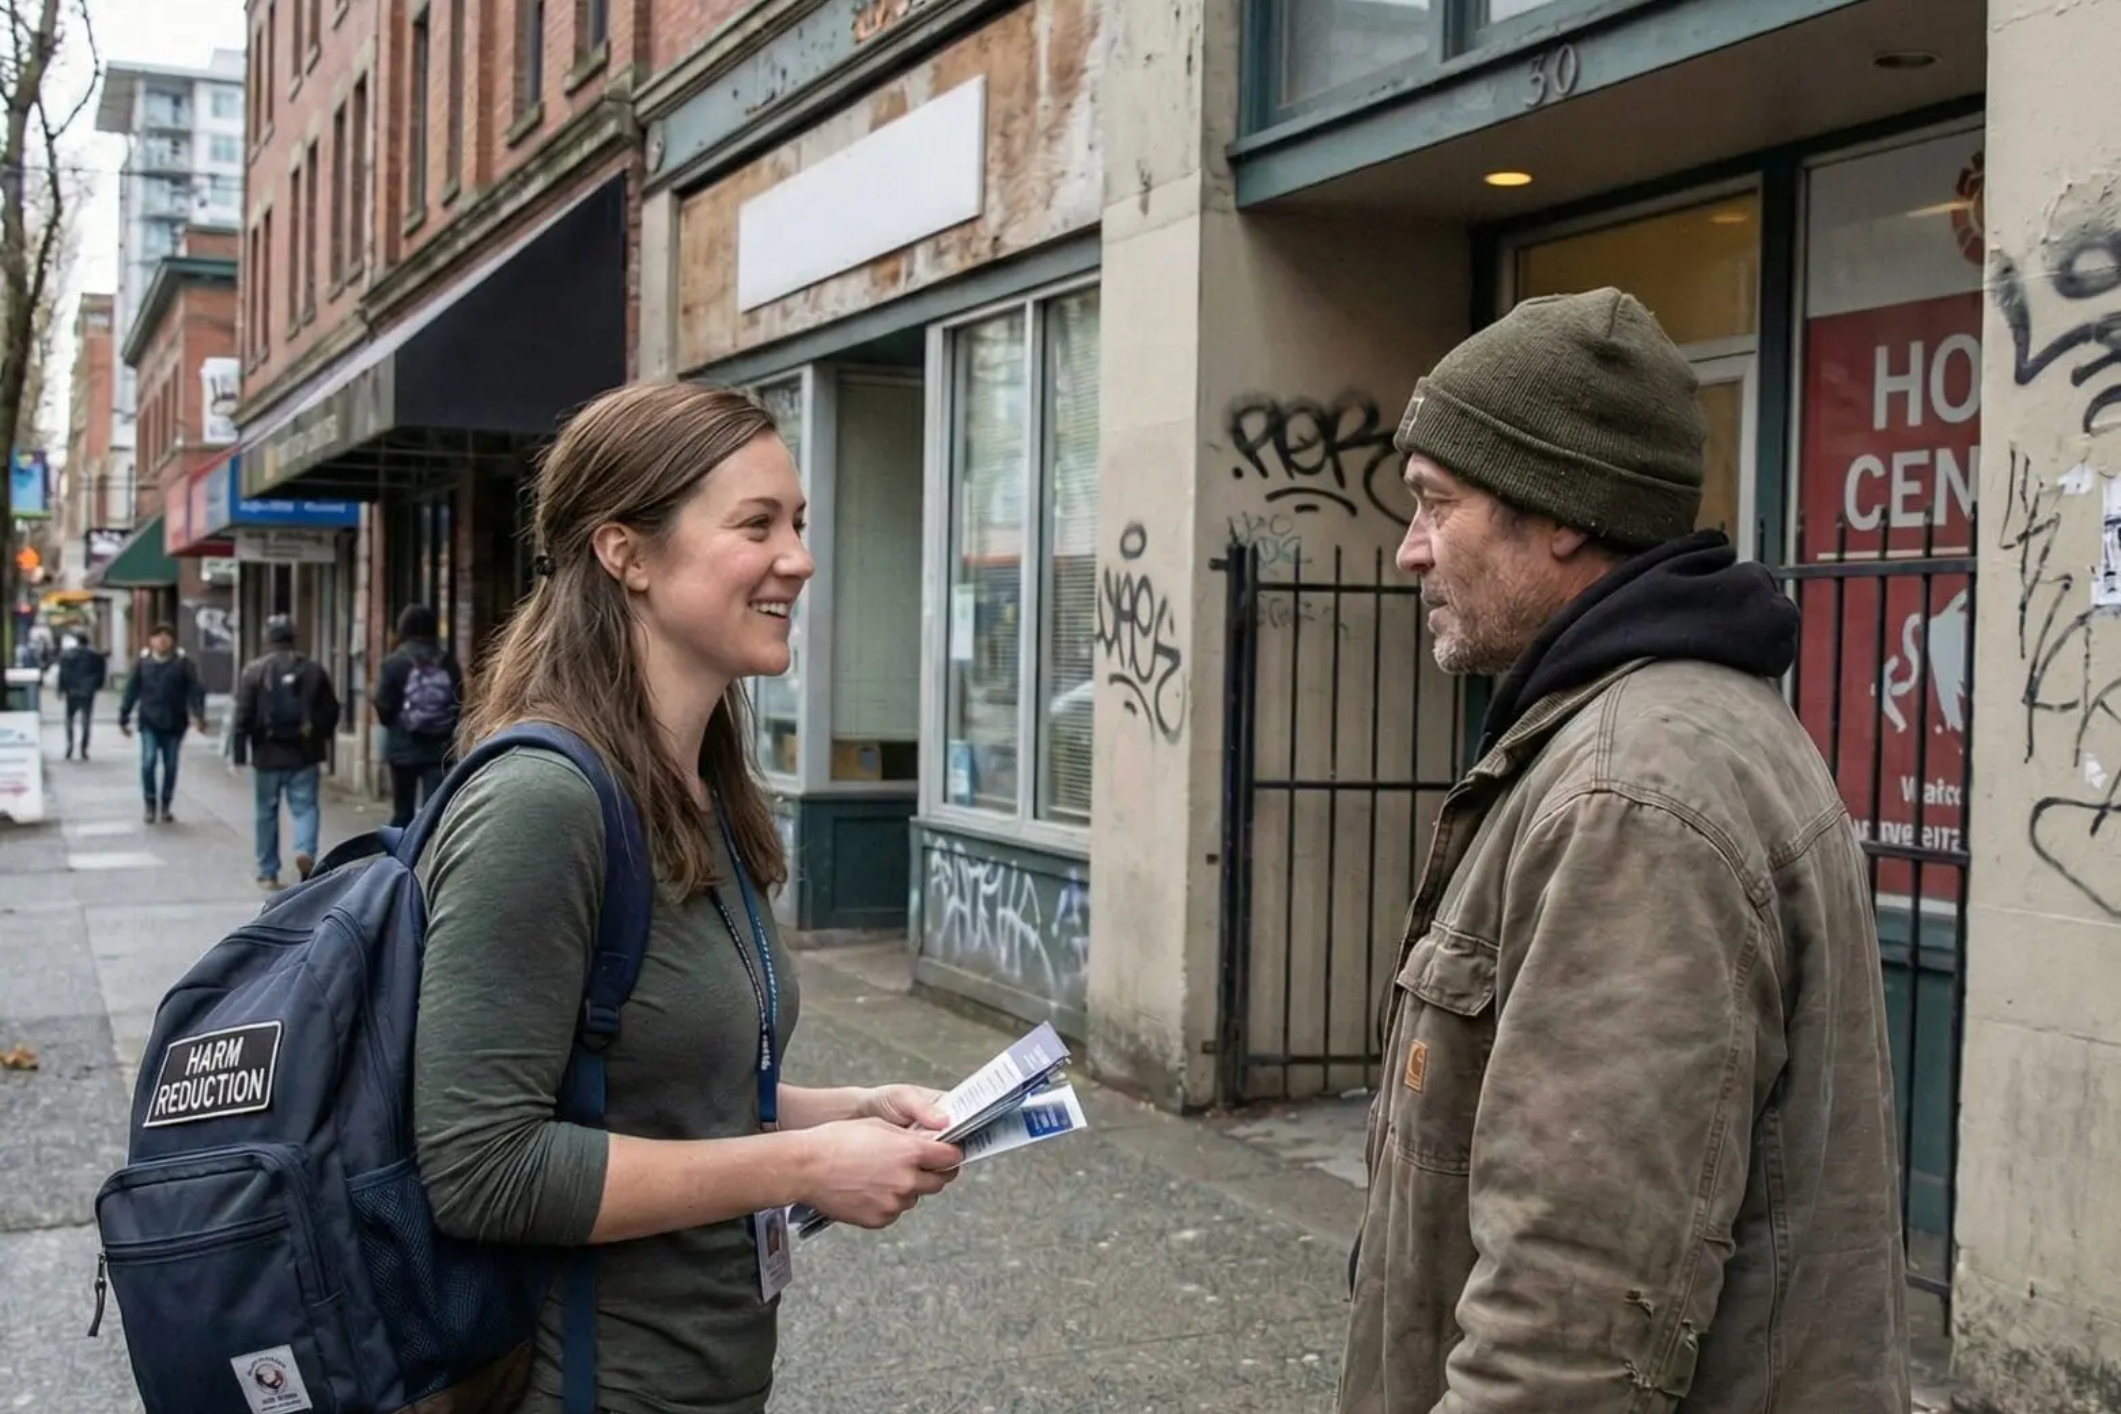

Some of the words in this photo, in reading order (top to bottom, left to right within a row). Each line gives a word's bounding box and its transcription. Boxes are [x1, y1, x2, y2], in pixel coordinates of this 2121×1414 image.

[1525, 45, 1578, 108] 30
[1873, 333, 1982, 430] HO
[1844, 445, 1980, 531] CEN
[185, 1036, 245, 1076] HARM
[154, 1068, 266, 1117] REDUCTION
